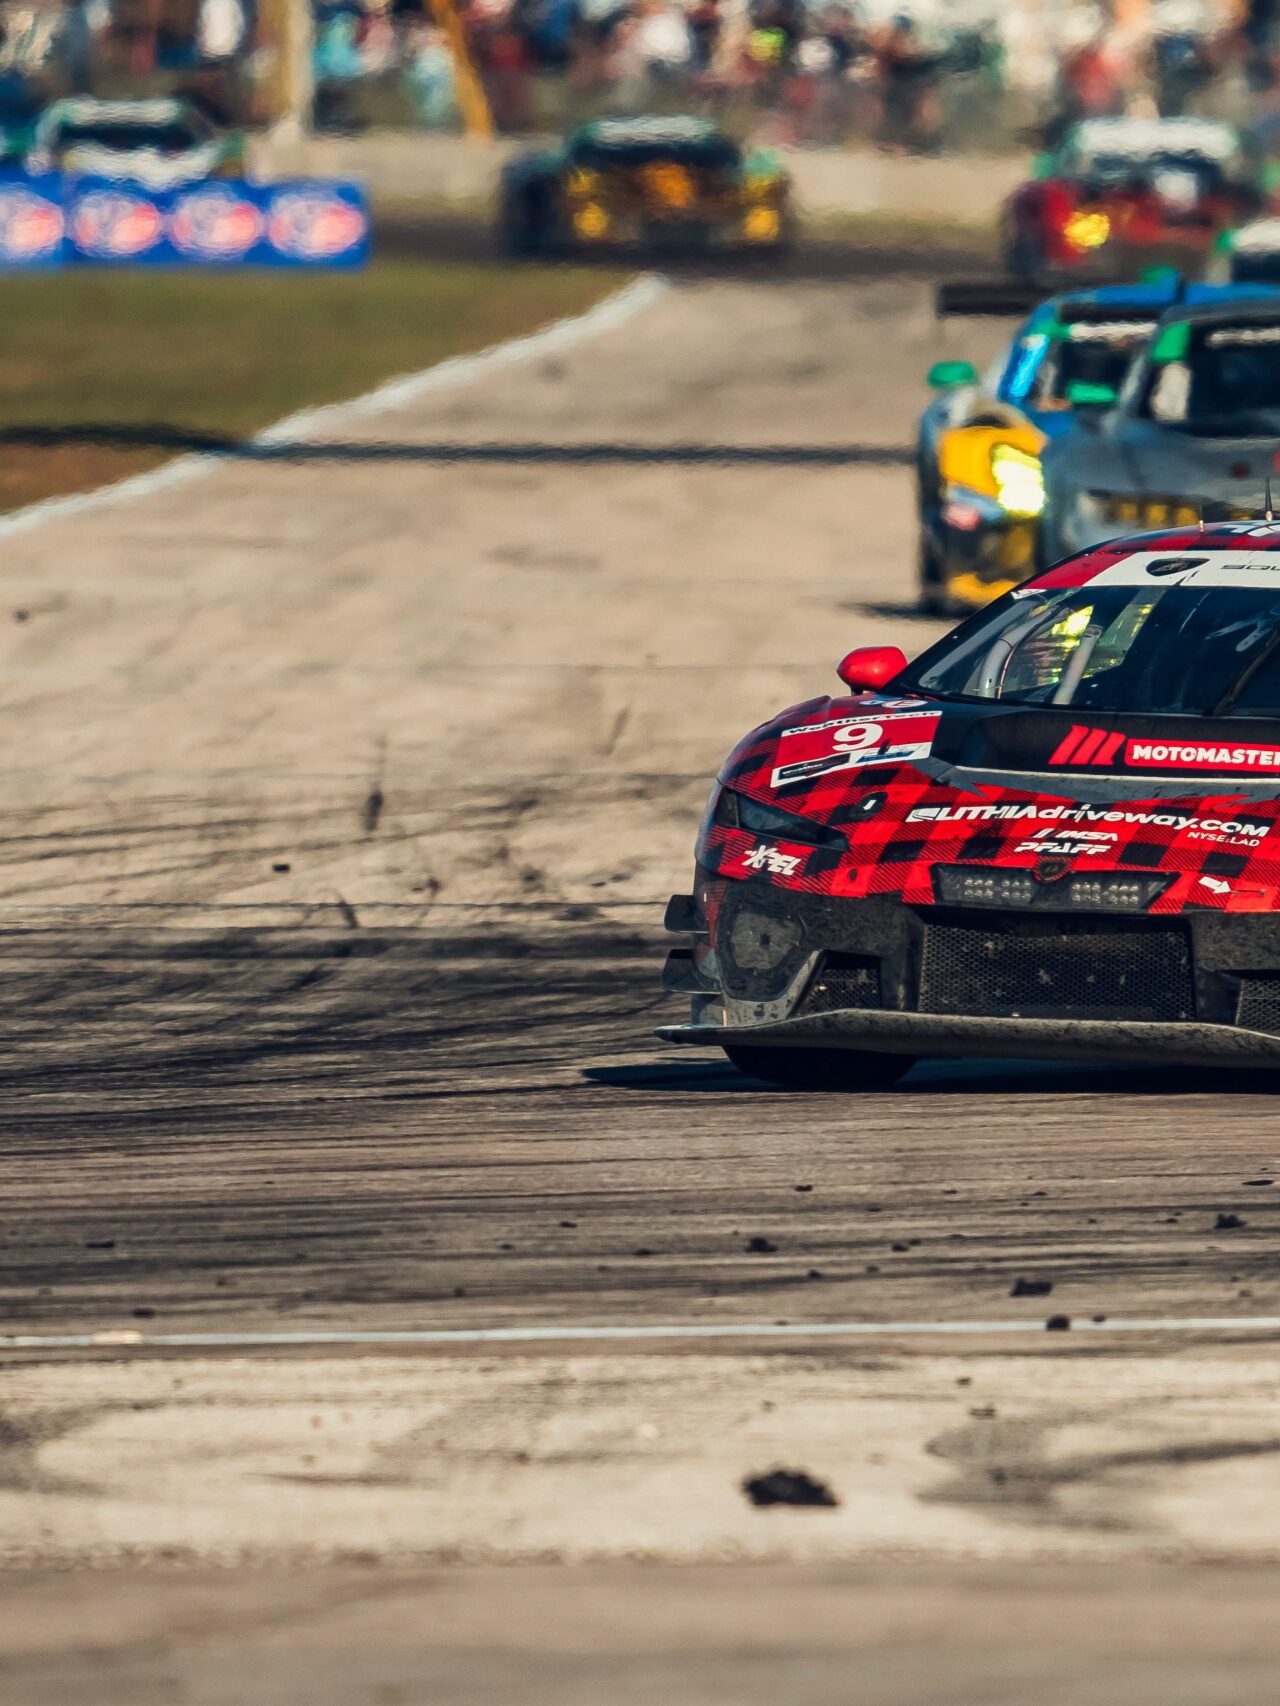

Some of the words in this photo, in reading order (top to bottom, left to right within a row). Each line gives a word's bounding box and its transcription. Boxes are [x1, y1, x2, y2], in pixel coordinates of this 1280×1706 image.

[789, 711, 936, 735] WeatherTech
[832, 723, 883, 751] 9
[1055, 830, 1118, 841] IMSA
[1187, 832, 1260, 847] NYSE:LAD
[1014, 842, 1111, 855] PFAFF
[742, 845, 802, 875] XPEL
